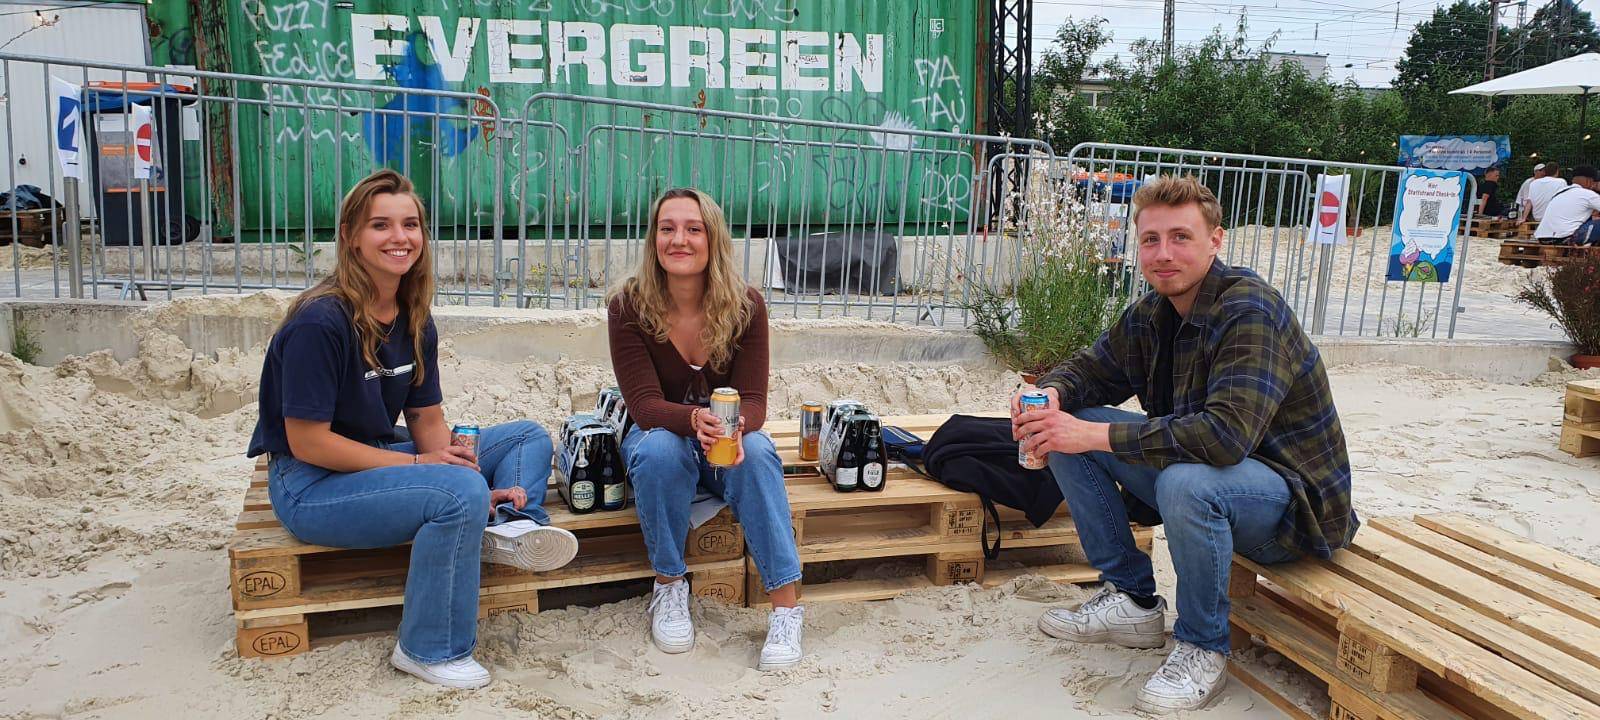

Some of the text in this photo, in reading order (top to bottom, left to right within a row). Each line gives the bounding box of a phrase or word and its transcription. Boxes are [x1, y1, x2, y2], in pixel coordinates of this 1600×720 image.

[350, 13, 884, 93] EVERGREEN
[245, 576, 279, 593] EPAL
[260, 635, 293, 652] EPAL
